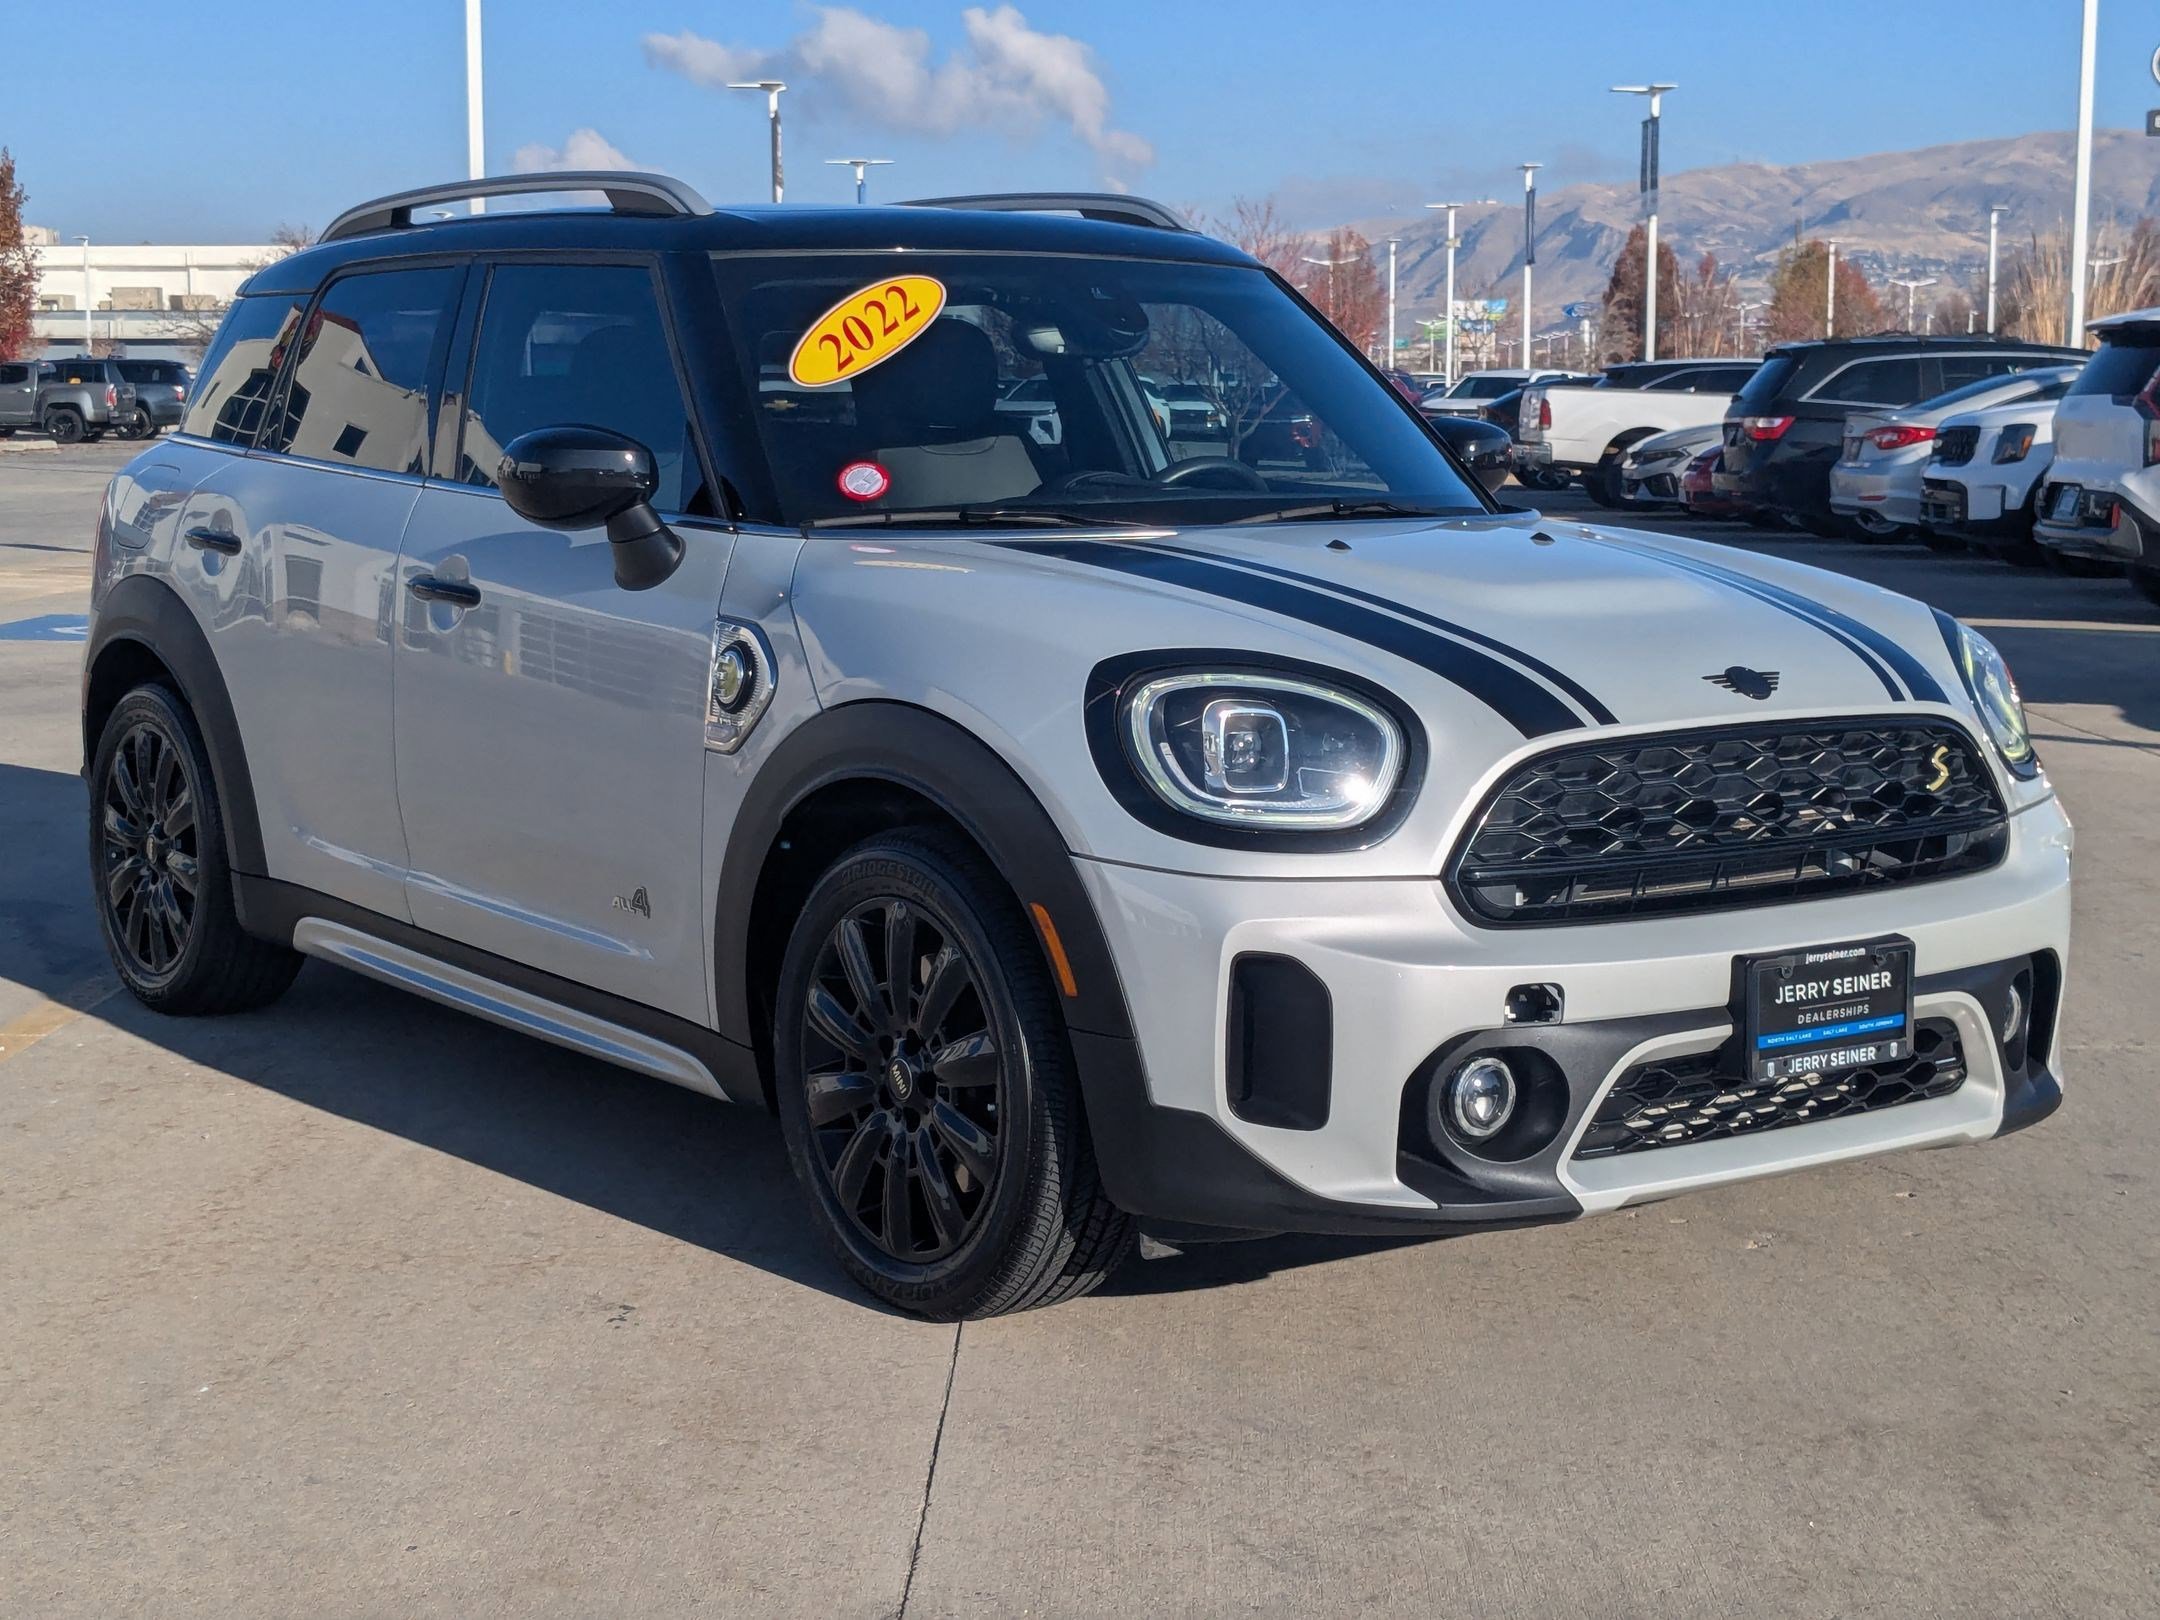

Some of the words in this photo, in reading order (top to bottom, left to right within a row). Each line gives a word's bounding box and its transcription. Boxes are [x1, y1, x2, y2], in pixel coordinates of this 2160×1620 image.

[818, 285, 921, 373] 2022
[1926, 745, 1950, 792] S
[1805, 947, 1866, 965] jerryseiner.com
[1775, 979, 1830, 1005] JERRY
[1832, 971, 1892, 997] SEINER
[1797, 1004, 1870, 1025] DEALERSHIPS
[1799, 1032, 1812, 1040] LAKE
[1788, 1053, 1829, 1074] JERRY
[1830, 1046, 1876, 1067] SEINER
[892, 1064, 907, 1094] MINI
